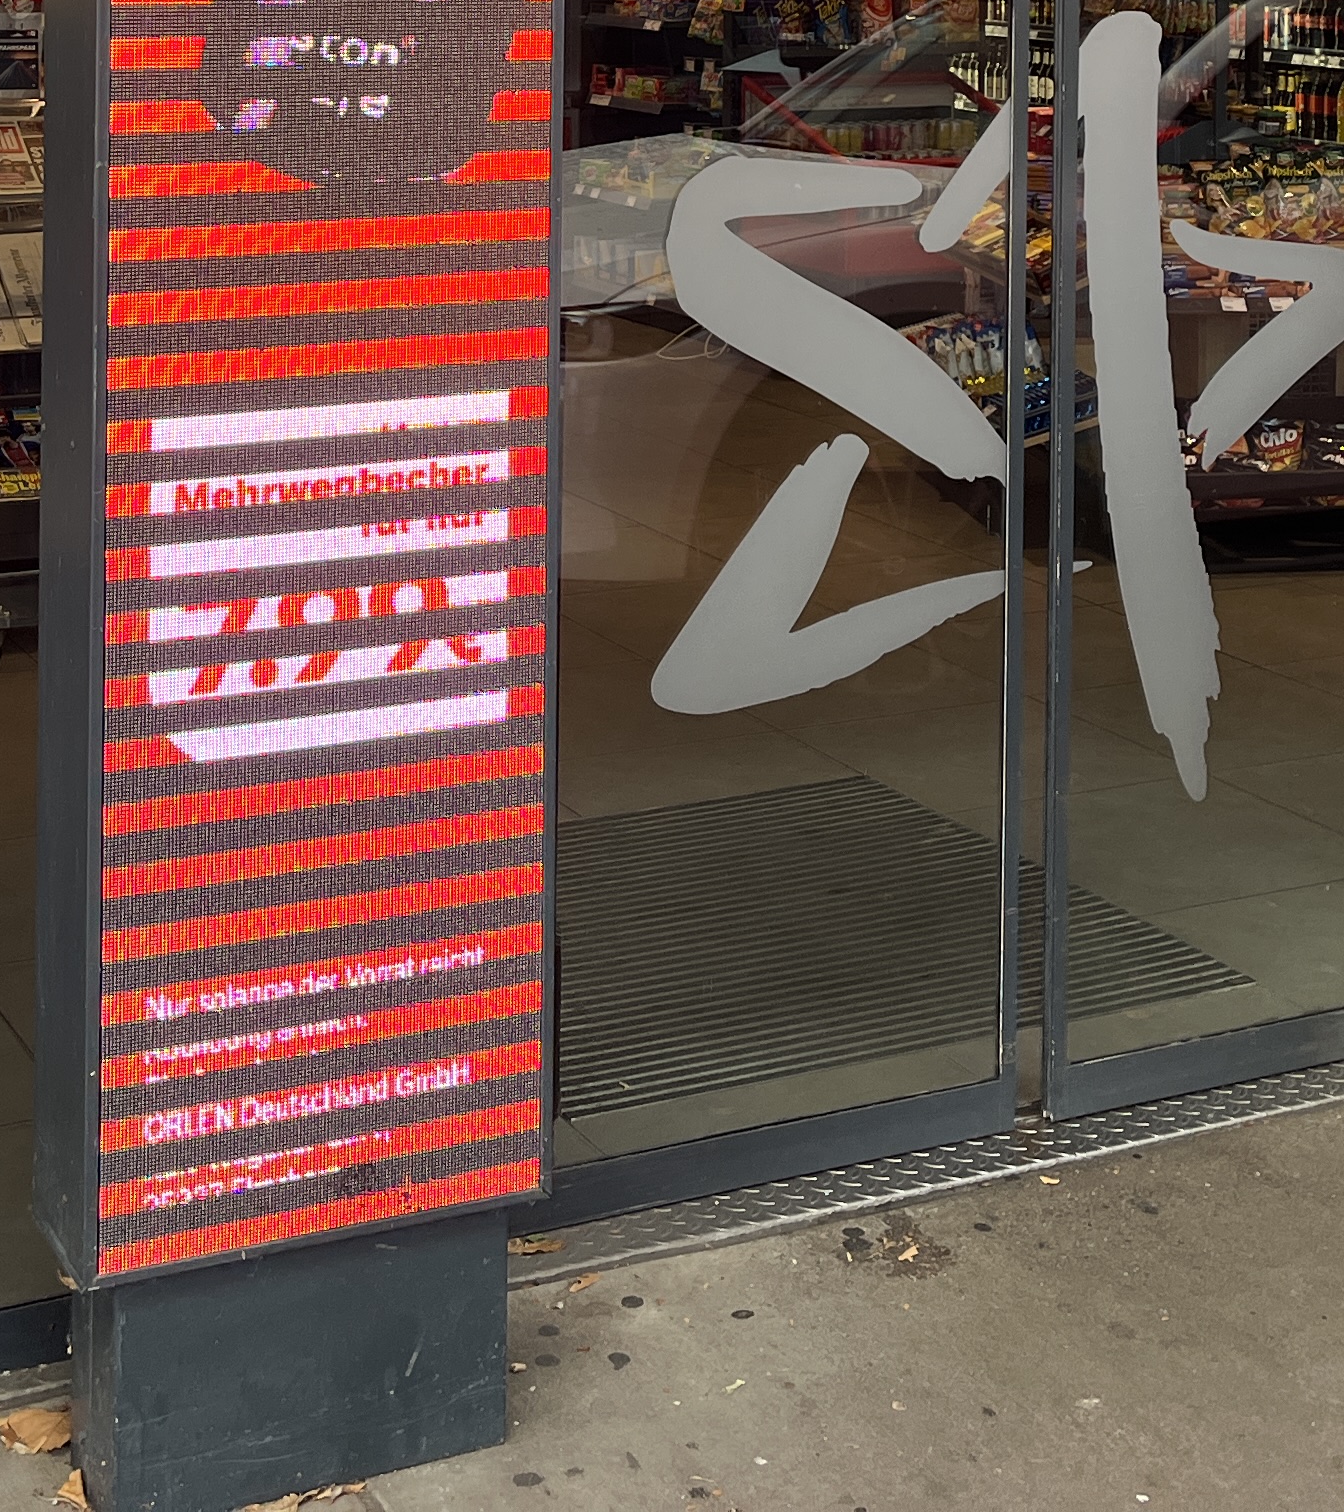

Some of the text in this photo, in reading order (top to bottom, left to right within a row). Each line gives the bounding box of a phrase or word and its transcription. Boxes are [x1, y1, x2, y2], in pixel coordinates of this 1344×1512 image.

[1260, 427, 1298, 448] Chio
[240, 1074, 388, 1125] Deutschland
[394, 1058, 473, 1095] GmbH
